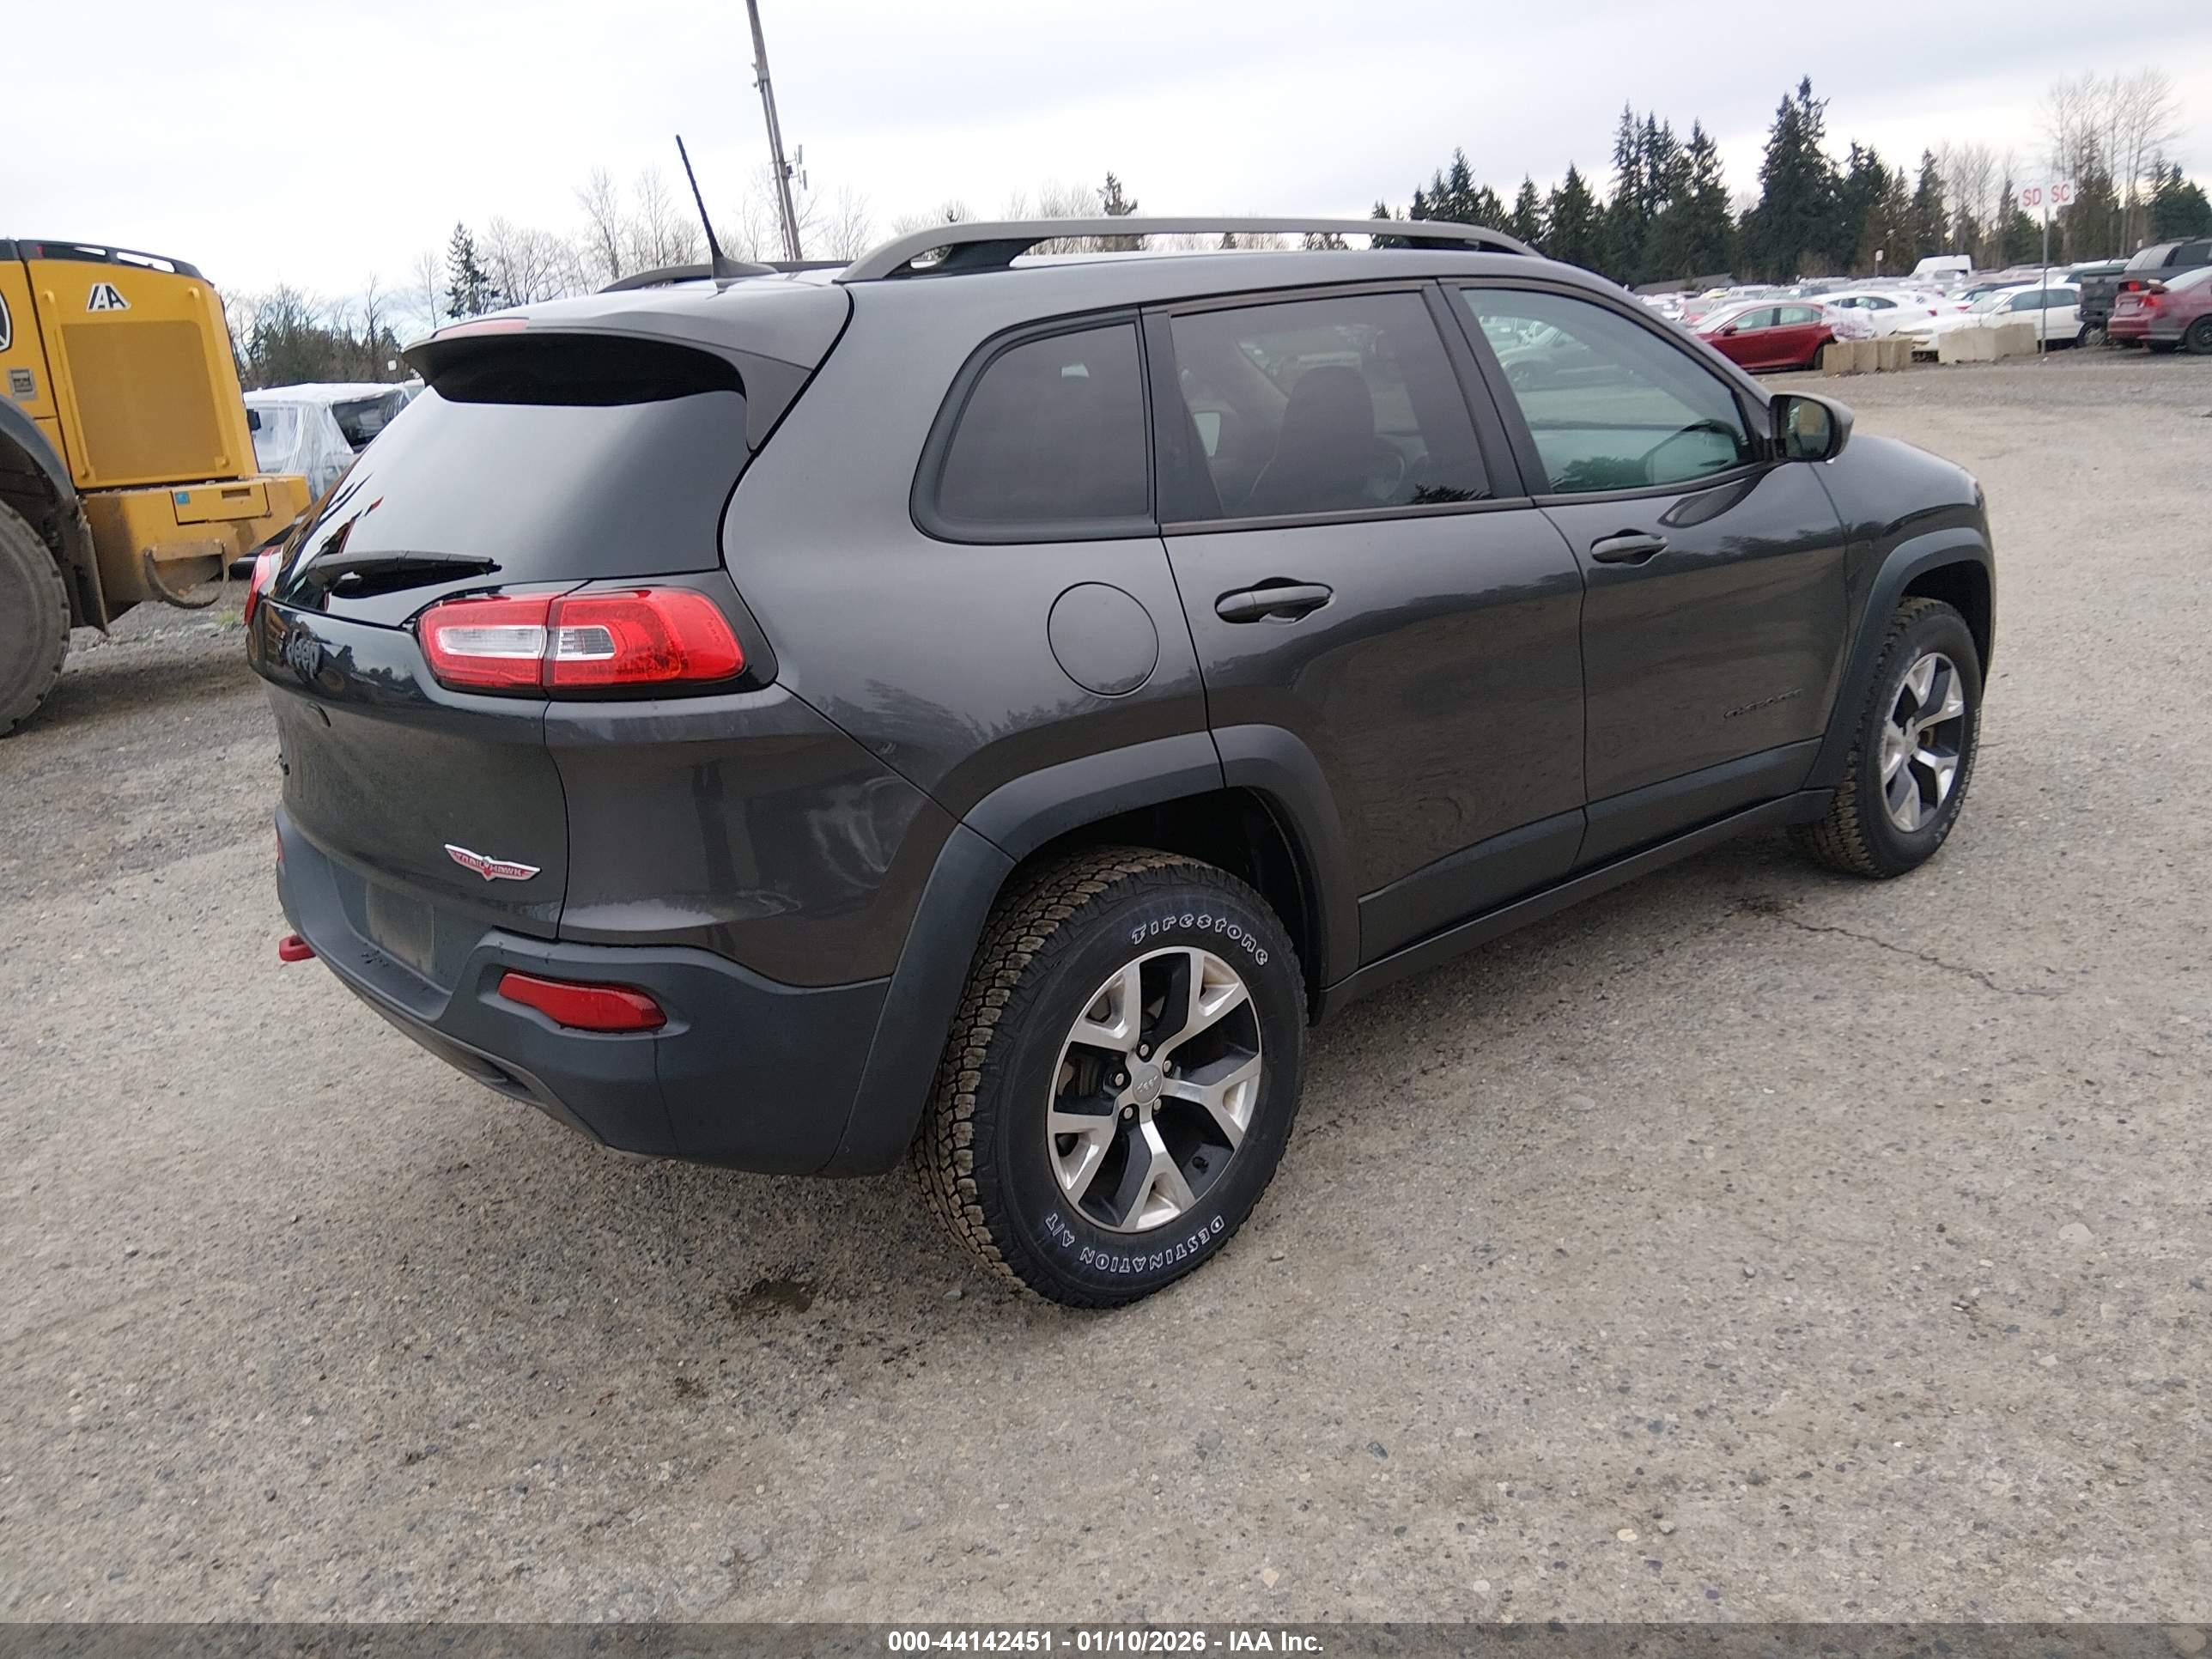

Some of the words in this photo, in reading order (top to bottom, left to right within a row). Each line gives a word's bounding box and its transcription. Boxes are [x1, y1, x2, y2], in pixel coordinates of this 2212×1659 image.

[2022, 188, 2041, 206] SD
[2051, 183, 2069, 203] SC
[1131, 913, 1268, 966] Firestone
[1045, 1212, 1075, 1247] A/T
[1079, 1214, 1224, 1274] DESTINATION
